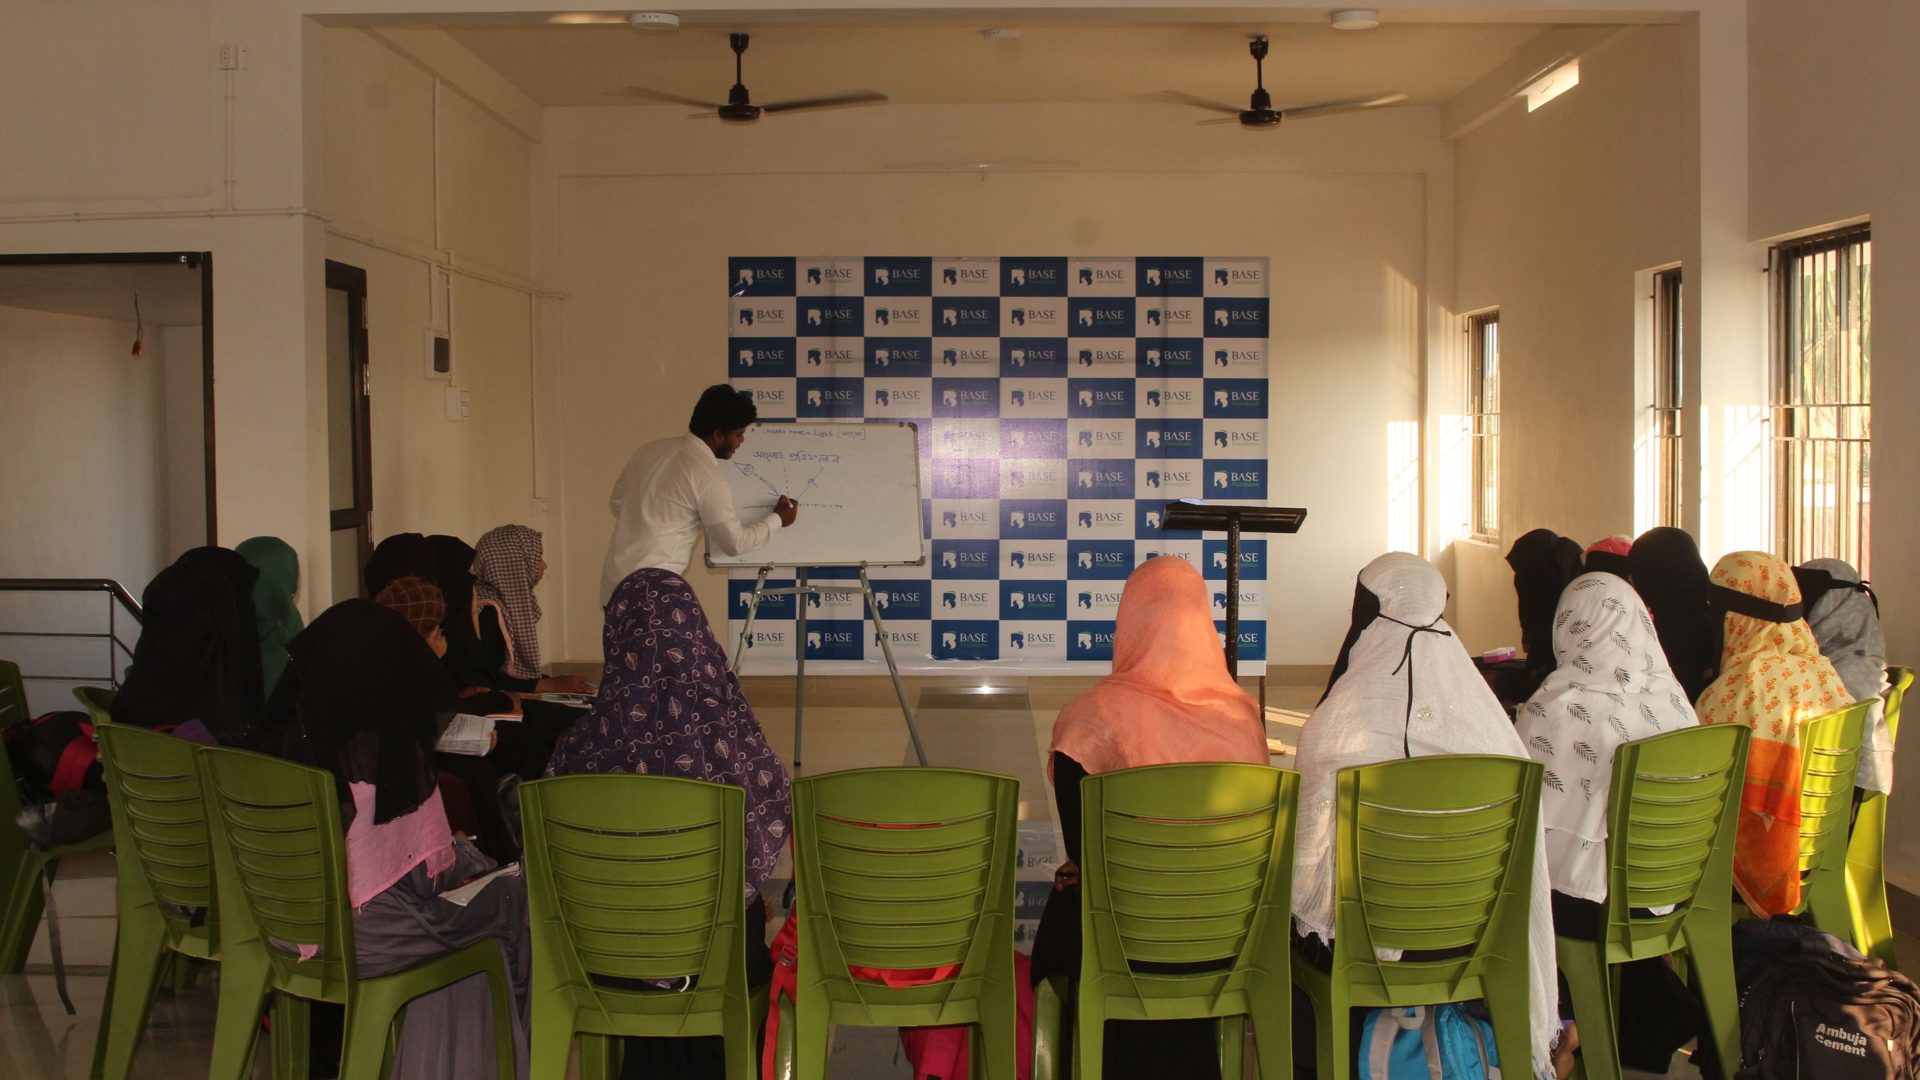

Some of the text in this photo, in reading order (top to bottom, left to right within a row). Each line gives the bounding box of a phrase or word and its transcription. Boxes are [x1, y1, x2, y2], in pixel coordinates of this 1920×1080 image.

[756, 269, 784, 278] BASE
[824, 269, 852, 279] BASE
[892, 269, 920, 279] BASE
[960, 270, 988, 279] BASE
[1028, 270, 1056, 279] BASE
[1096, 270, 1124, 279] BASE
[1164, 270, 1192, 279] BASE
[1232, 270, 1260, 279] BASE
[756, 310, 784, 319] BASE
[824, 310, 852, 319] BASE
[892, 310, 920, 319] BASE
[960, 310, 988, 320] BASE
[1028, 310, 1056, 320] BASE
[1096, 310, 1124, 320] BASE
[1164, 310, 1192, 320] BASE
[1232, 310, 1259, 320] BASE
[756, 350, 784, 360] BASE
[824, 350, 852, 360] BASE
[892, 350, 920, 360] BASE
[960, 351, 988, 360] BASE
[1028, 351, 1056, 360] BASE
[1096, 351, 1124, 360] BASE
[1164, 351, 1192, 360] BASE
[1231, 351, 1259, 360] BASE
[756, 390, 784, 400] BASE
[824, 391, 852, 400] BASE
[892, 391, 920, 400] BASE
[960, 391, 988, 401] BASE
[1028, 391, 1056, 401] BASE
[1096, 391, 1124, 401] BASE
[1164, 391, 1192, 401] BASE
[1231, 391, 1259, 401] BASE
[1096, 431, 1124, 441] BASE
[1164, 431, 1192, 441] BASE
[1231, 431, 1259, 441] BASE
[1096, 472, 1123, 481] BASE
[1164, 472, 1191, 481] BASE
[1231, 472, 1259, 481] BASE
[960, 512, 988, 522] BASE
[1028, 512, 1055, 522] BASE
[1095, 512, 1123, 522] BASE
[960, 553, 988, 562] BASE
[1027, 553, 1055, 562] BASE
[1095, 553, 1123, 562] BASE
[1240, 553, 1259, 562] ASE
[824, 593, 852, 602] BASE
[892, 593, 920, 602] BASE
[960, 593, 987, 602] BASE
[1027, 593, 1055, 602] BASE
[756, 633, 784, 642] BASE
[824, 633, 852, 642] BASE
[892, 633, 920, 643] BASE
[960, 633, 987, 643] BASE
[1027, 633, 1055, 643] BASE
[1237, 633, 1259, 643] ASE
[1815, 1023, 1867, 1046] Ambuja
[1815, 1034, 1866, 1057] Cement
